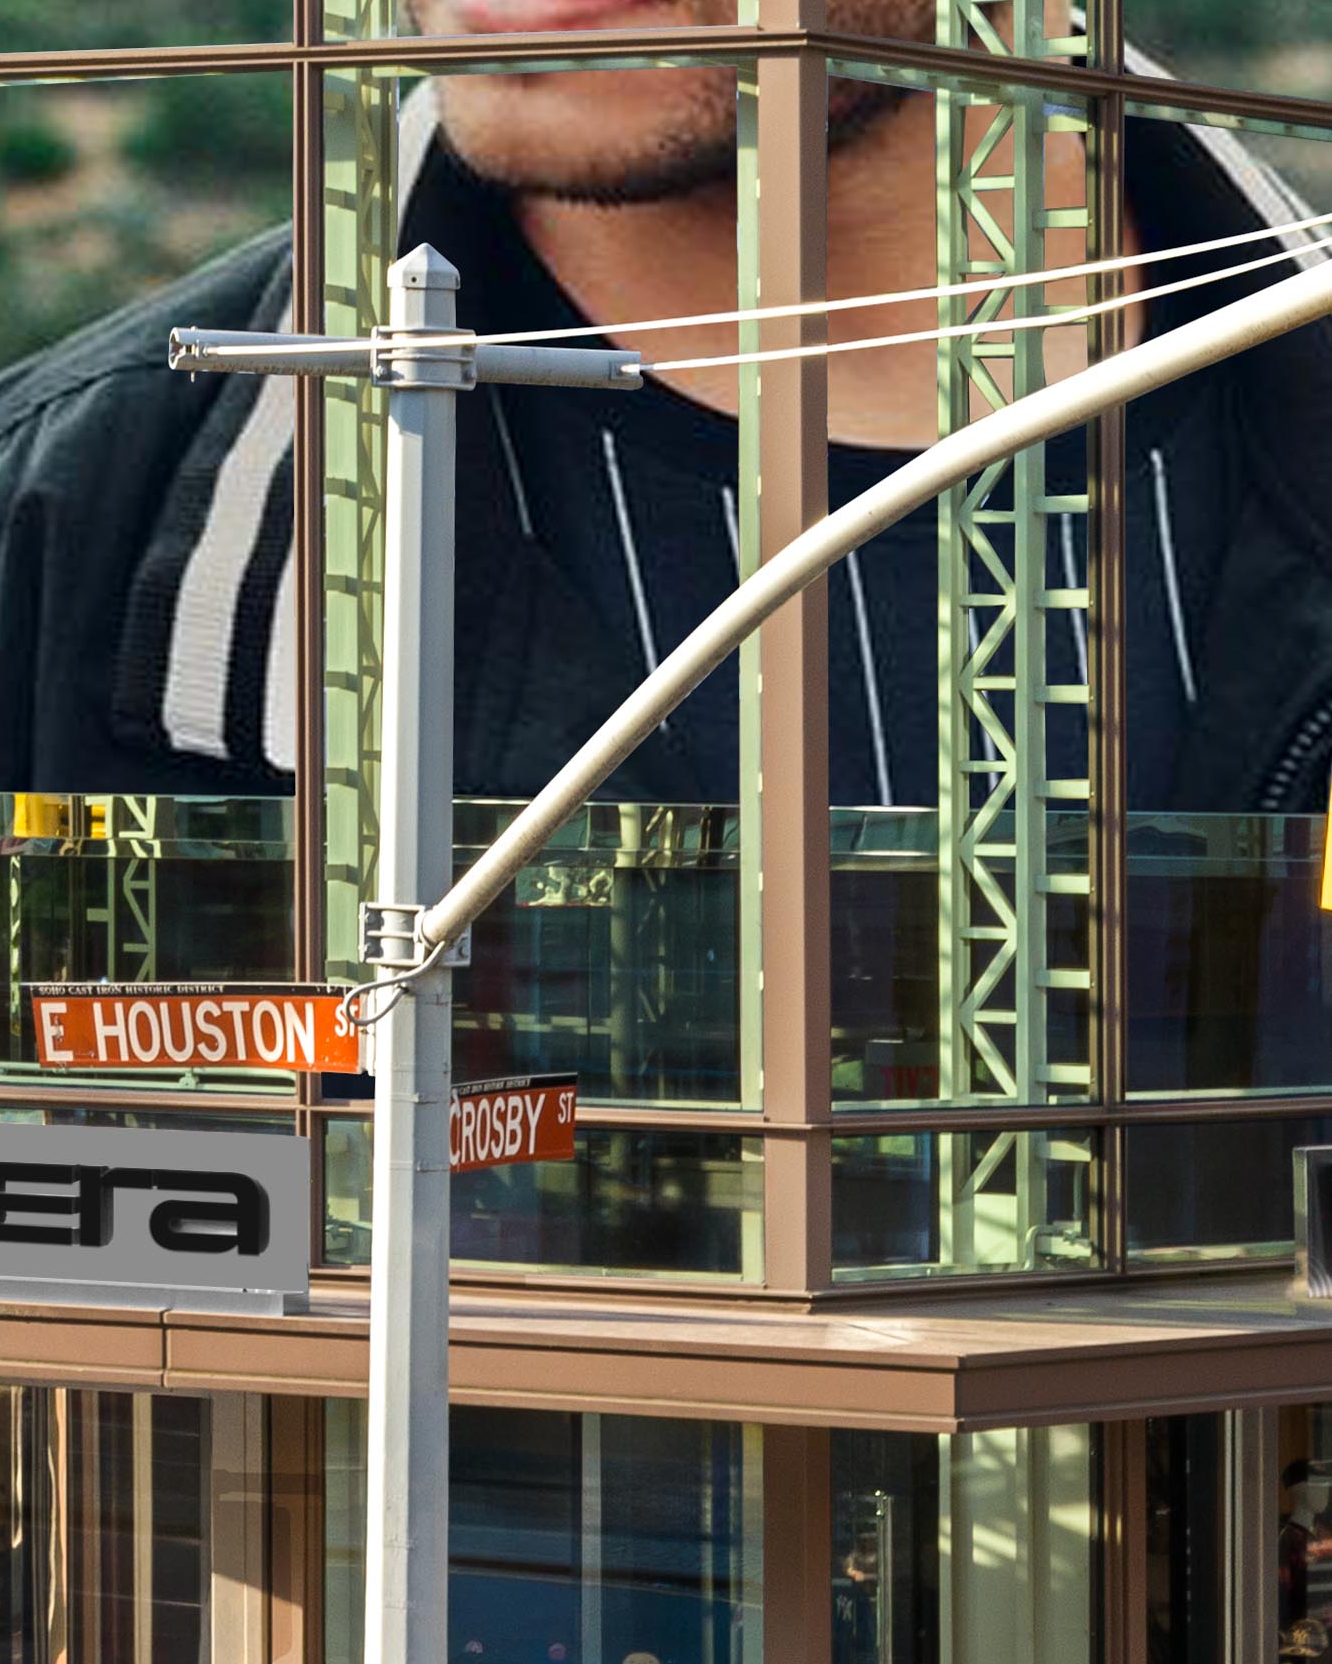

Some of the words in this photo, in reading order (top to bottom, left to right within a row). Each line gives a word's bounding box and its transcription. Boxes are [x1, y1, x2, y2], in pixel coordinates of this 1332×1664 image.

[39, 985, 65, 995] SOHO
[68, 985, 93, 995] CAST
[96, 985, 122, 995] IRON
[125, 985, 174, 995] HISTORIC
[177, 984, 225, 994] DISTRICT
[40, 1002, 74, 1062] E
[92, 1000, 315, 1064] HOUSTON
[334, 1003, 359, 1038] ST
[449, 1093, 546, 1166] CROSBY
[557, 1092, 574, 1124] ST
